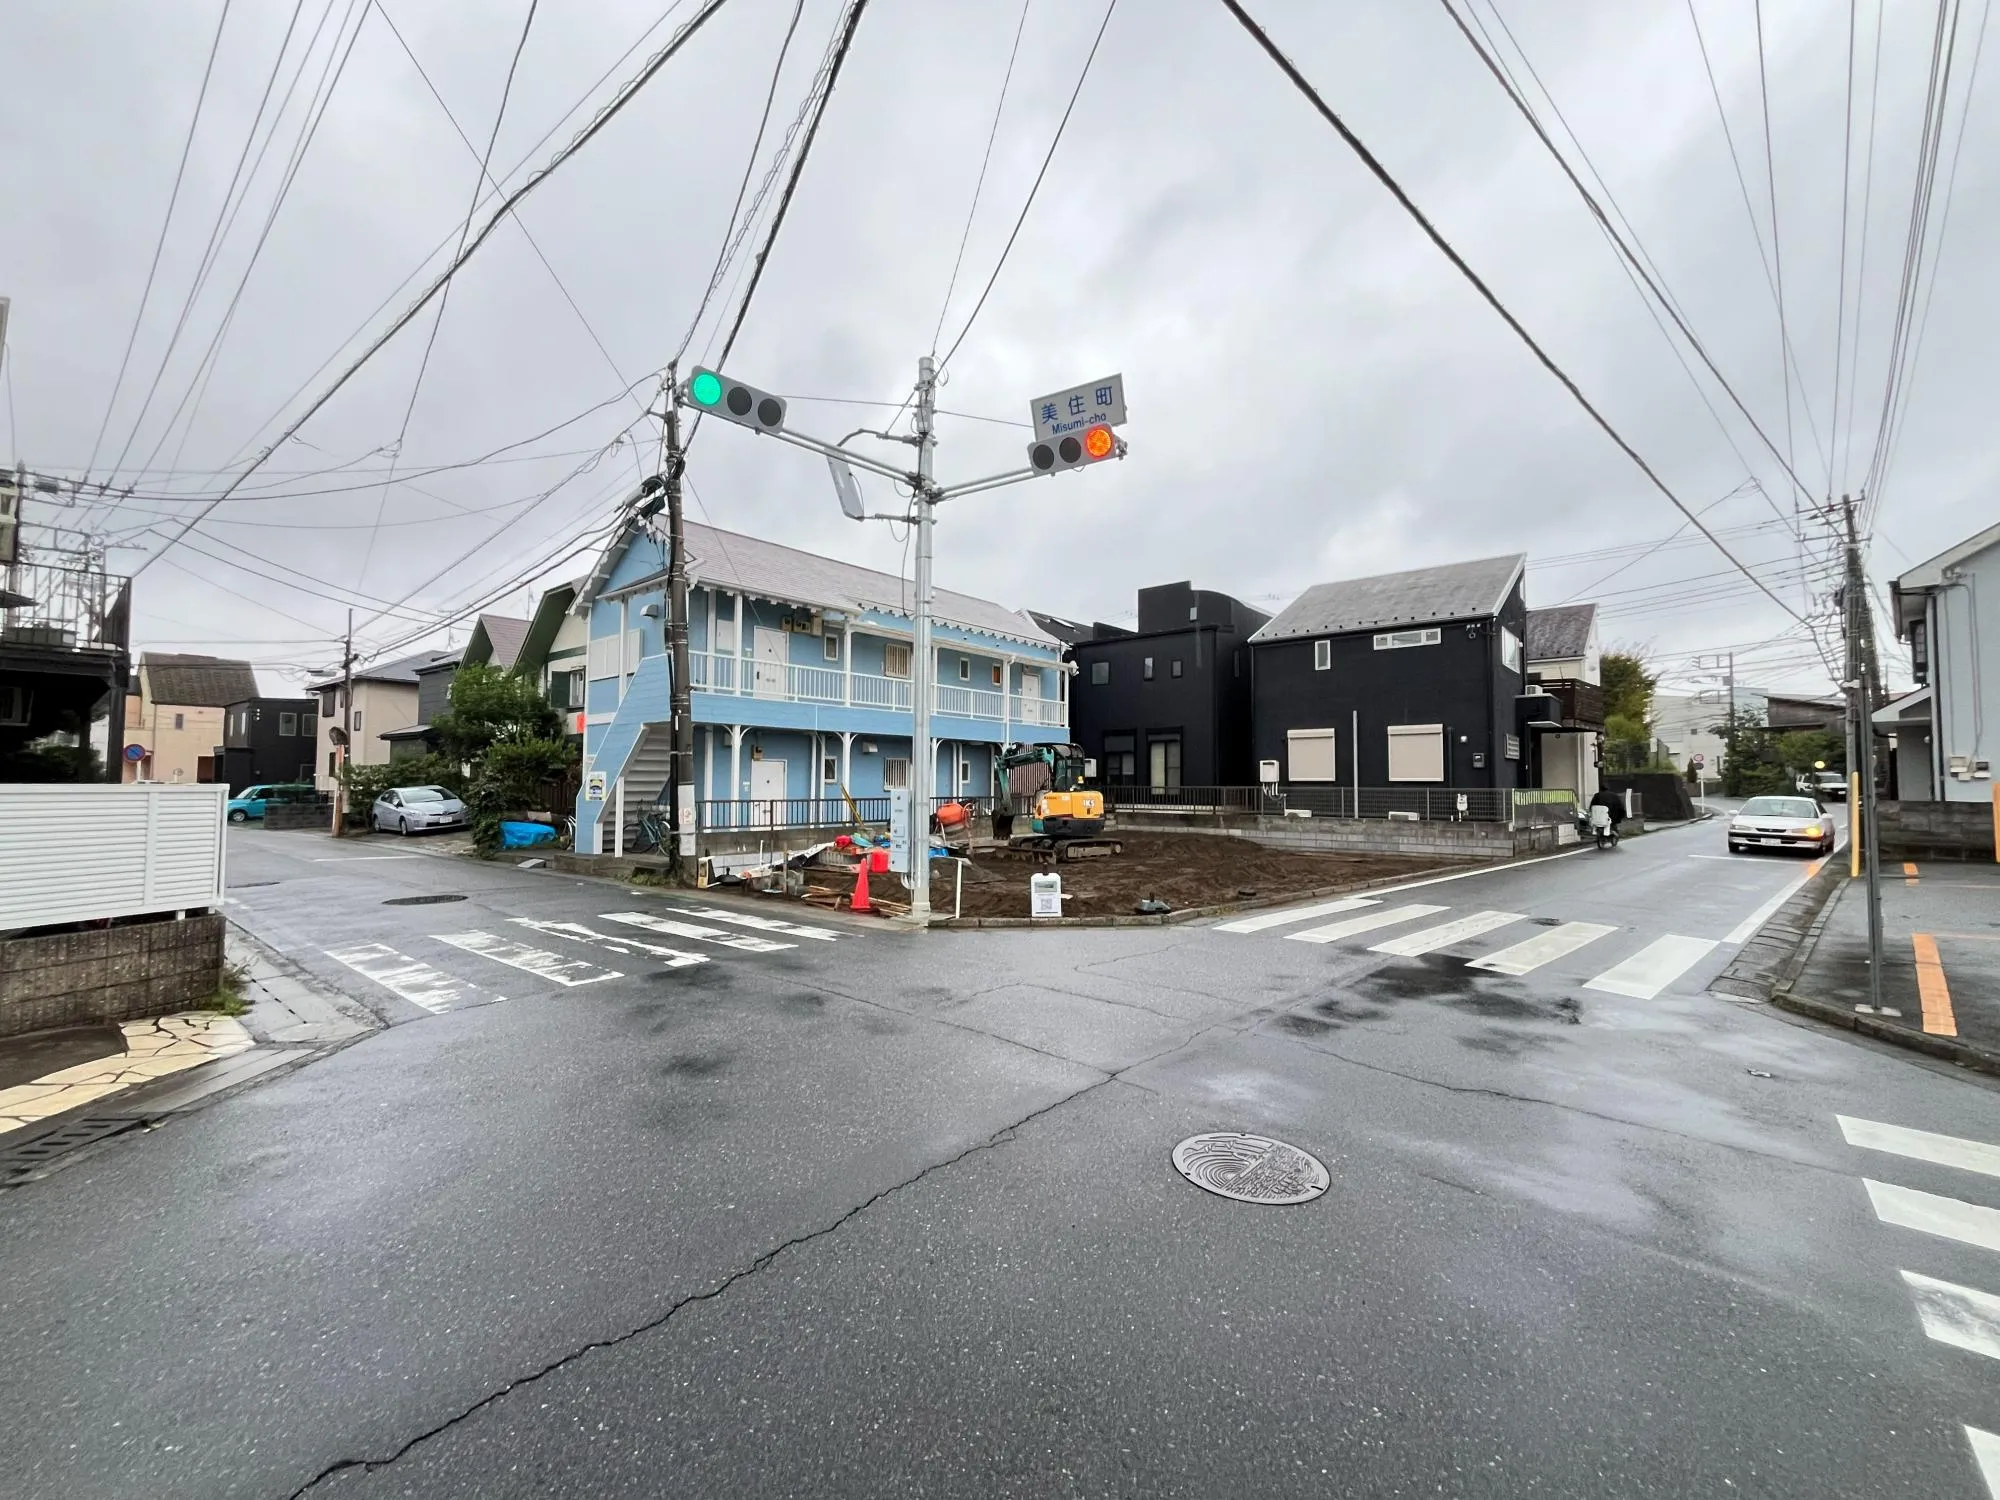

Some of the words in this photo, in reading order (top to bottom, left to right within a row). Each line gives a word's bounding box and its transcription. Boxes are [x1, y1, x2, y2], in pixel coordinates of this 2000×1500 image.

[1041, 386, 1112, 424] 美住町
[1052, 412, 1107, 435] Misumi-cho
